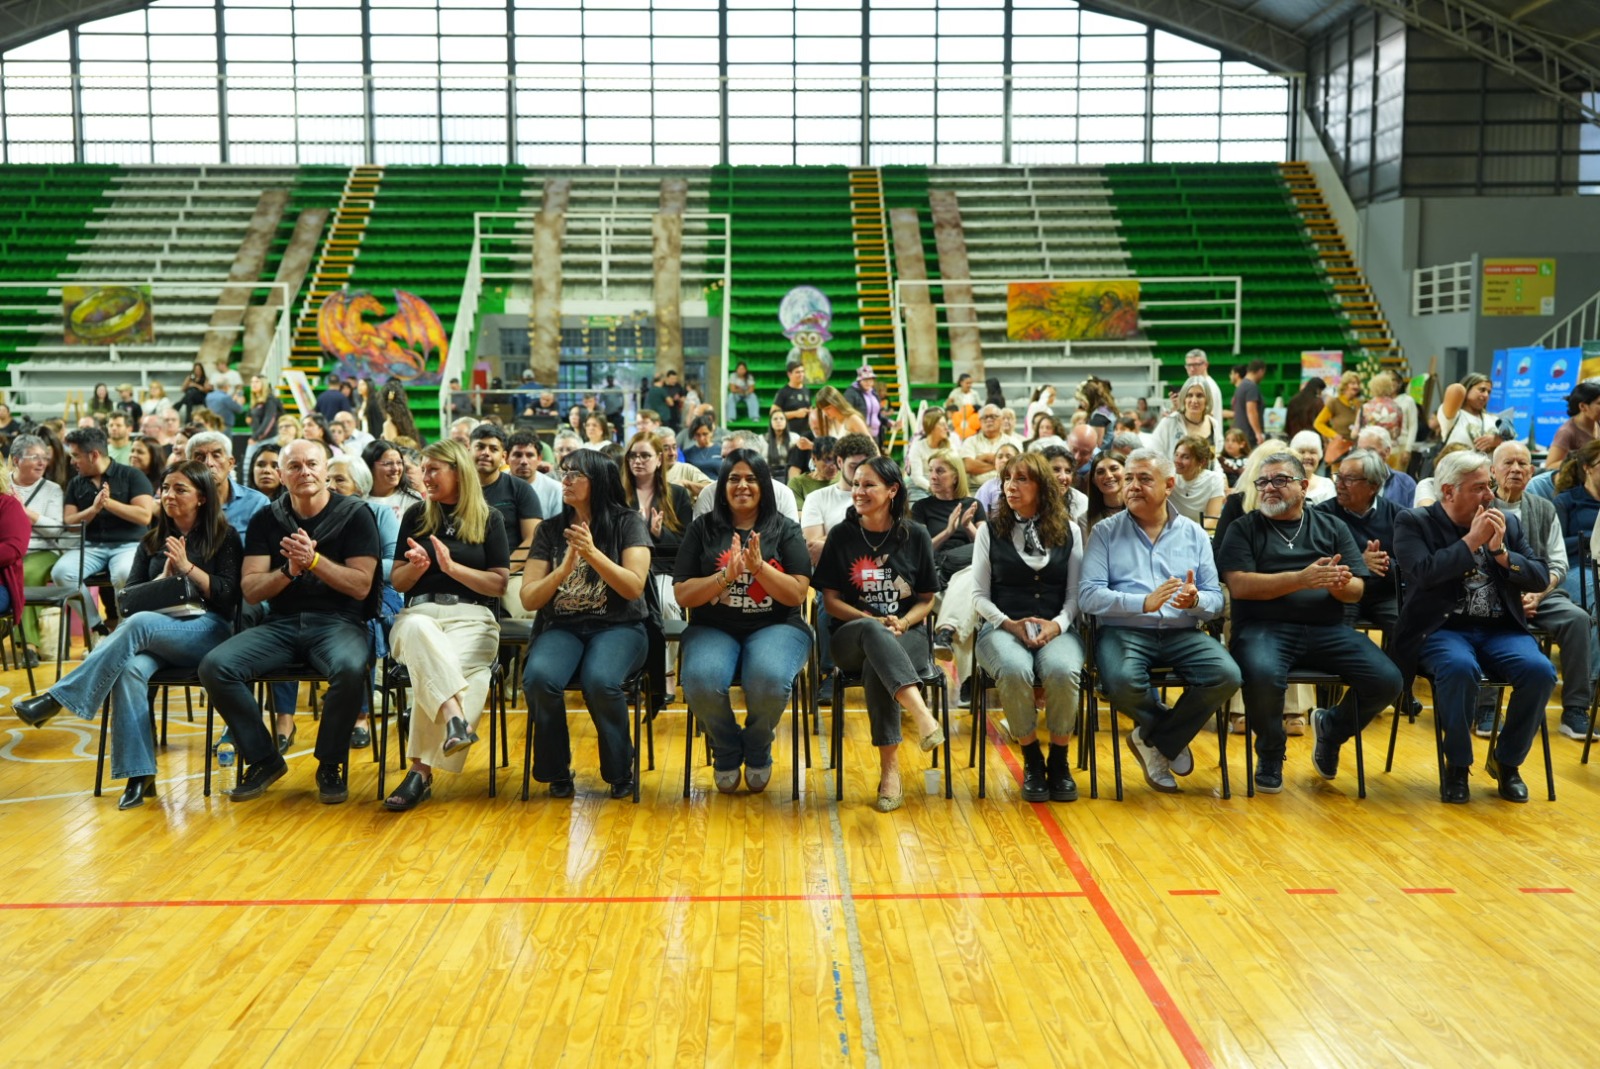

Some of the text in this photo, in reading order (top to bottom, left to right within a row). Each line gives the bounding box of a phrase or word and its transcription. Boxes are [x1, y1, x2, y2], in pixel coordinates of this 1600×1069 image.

[862, 569, 885, 580] FE
[863, 579, 895, 592] RIA
[729, 595, 772, 608] BRO
[865, 592, 884, 603] del
